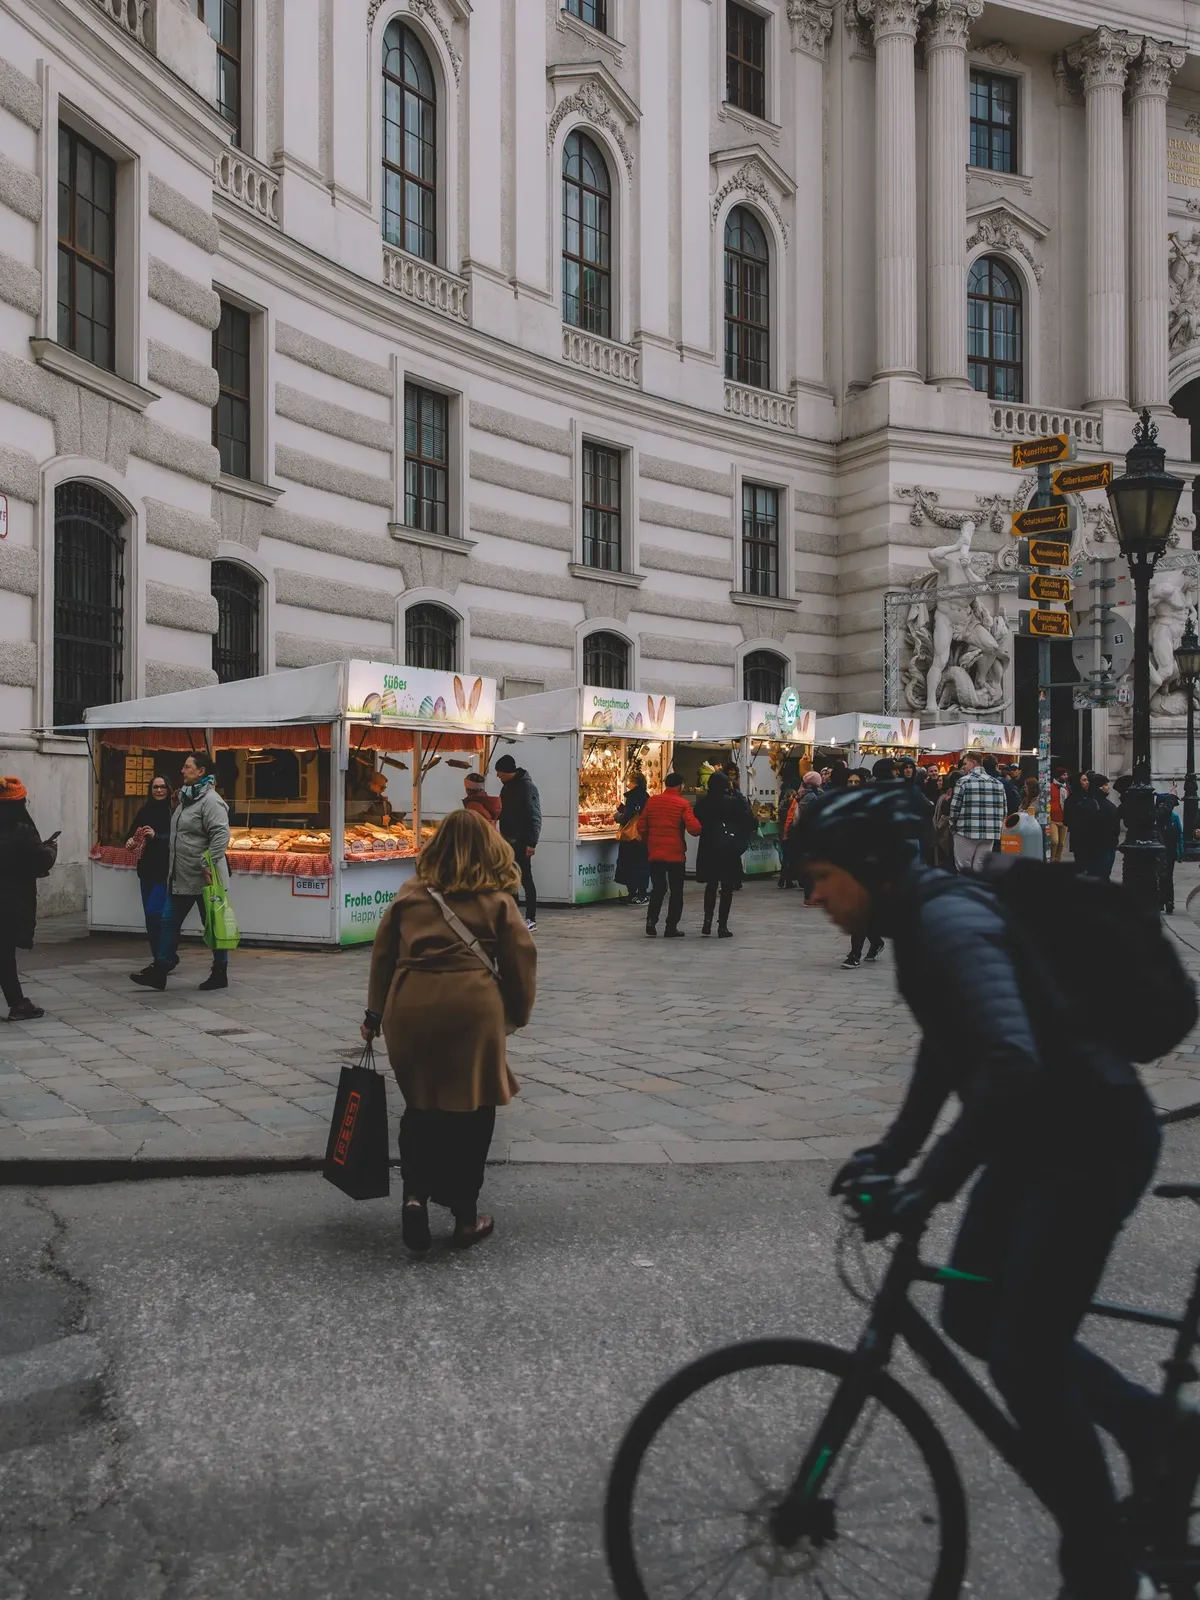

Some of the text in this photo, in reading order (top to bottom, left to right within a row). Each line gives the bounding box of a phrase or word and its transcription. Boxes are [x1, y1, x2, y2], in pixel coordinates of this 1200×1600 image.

[1023, 444, 1058, 457] Kunstforum
[1062, 473, 1099, 486] Silberkammer
[1022, 514, 1056, 526] Schatzkammer
[1039, 578, 1060, 589] Jüdisches
[383, 674, 408, 690] Süßes
[593, 695, 630, 710] Osterschmuck
[578, 862, 615, 876] Frohe Ostern
[296, 881, 326, 890] GEBIET
[344, 889, 399, 908] Frohe Oster
[350, 909, 377, 924] Happy
